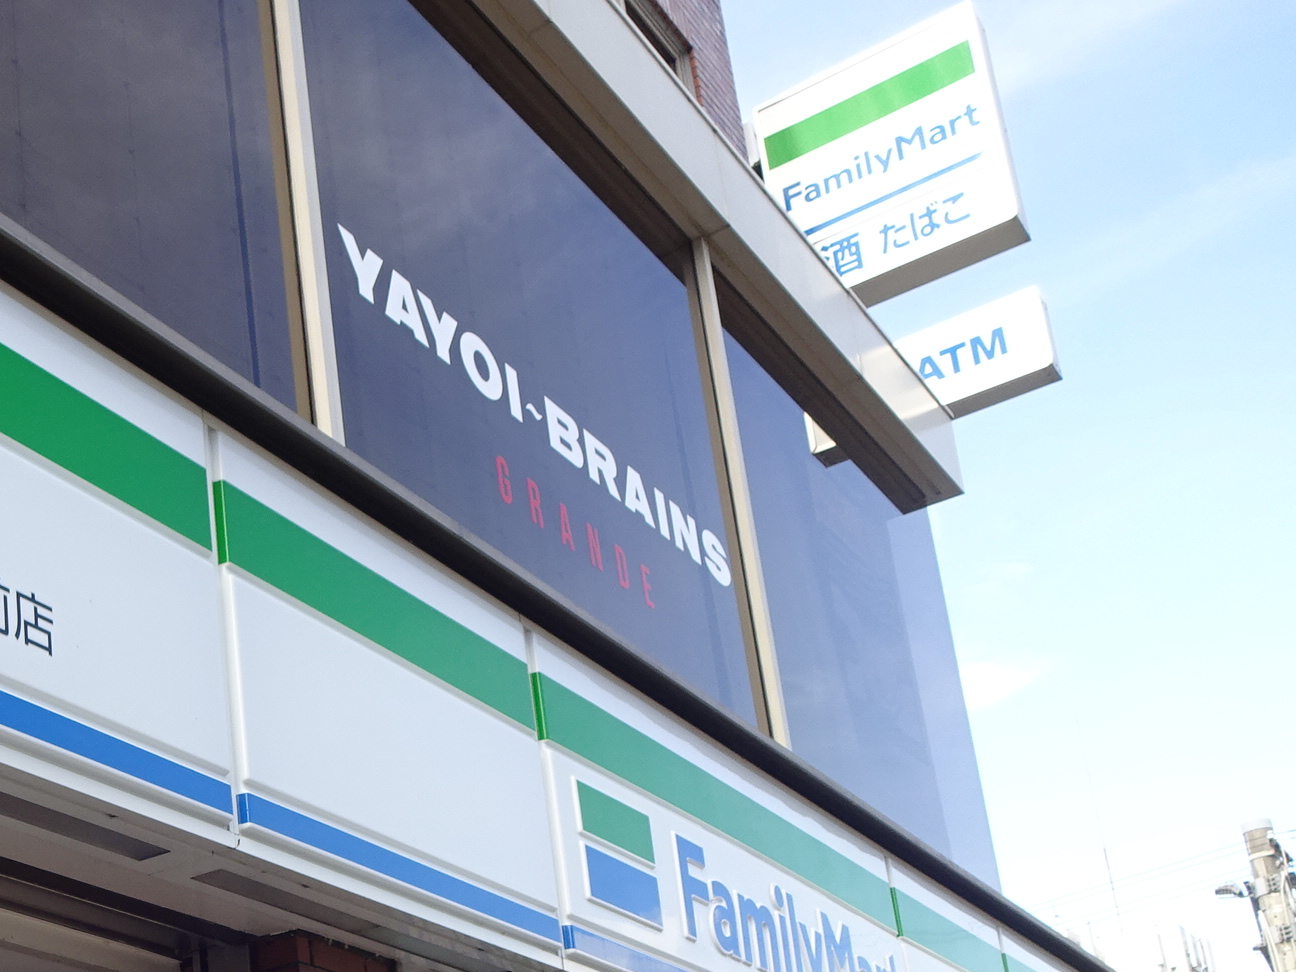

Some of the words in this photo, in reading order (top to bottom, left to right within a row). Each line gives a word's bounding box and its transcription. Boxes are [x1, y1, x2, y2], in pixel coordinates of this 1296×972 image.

[782, 104, 981, 212] FamilyMart
[879, 192, 972, 255] たばこ
[919, 327, 1008, 381] ATM
[496, 455, 655, 609] GRANDE
